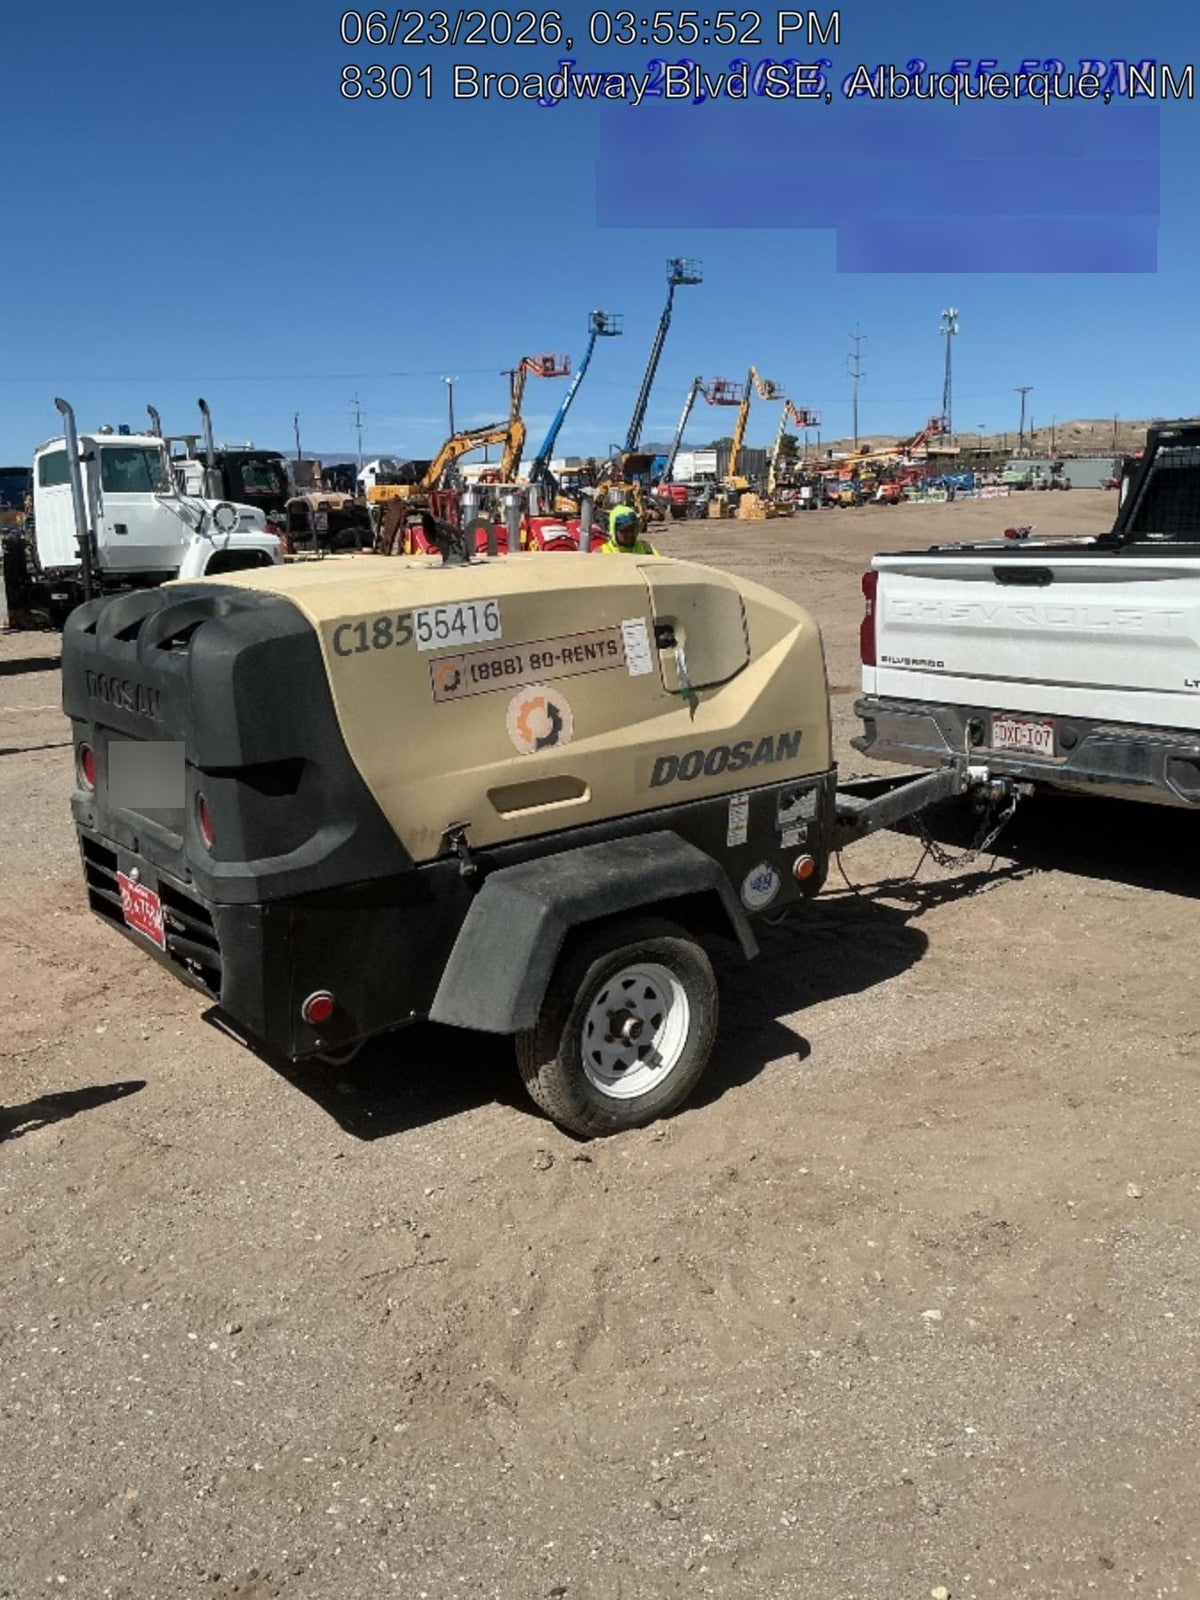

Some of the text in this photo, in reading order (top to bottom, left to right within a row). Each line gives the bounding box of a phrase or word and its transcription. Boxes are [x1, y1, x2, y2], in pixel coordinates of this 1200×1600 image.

[416, 602, 499, 643] 55416
[890, 599, 1184, 630] CHEVROLET
[333, 612, 413, 657] C185
[529, 639, 618, 670] 80-RENTS
[881, 655, 945, 668] SILVERADO
[648, 730, 803, 788] DOOSAN
